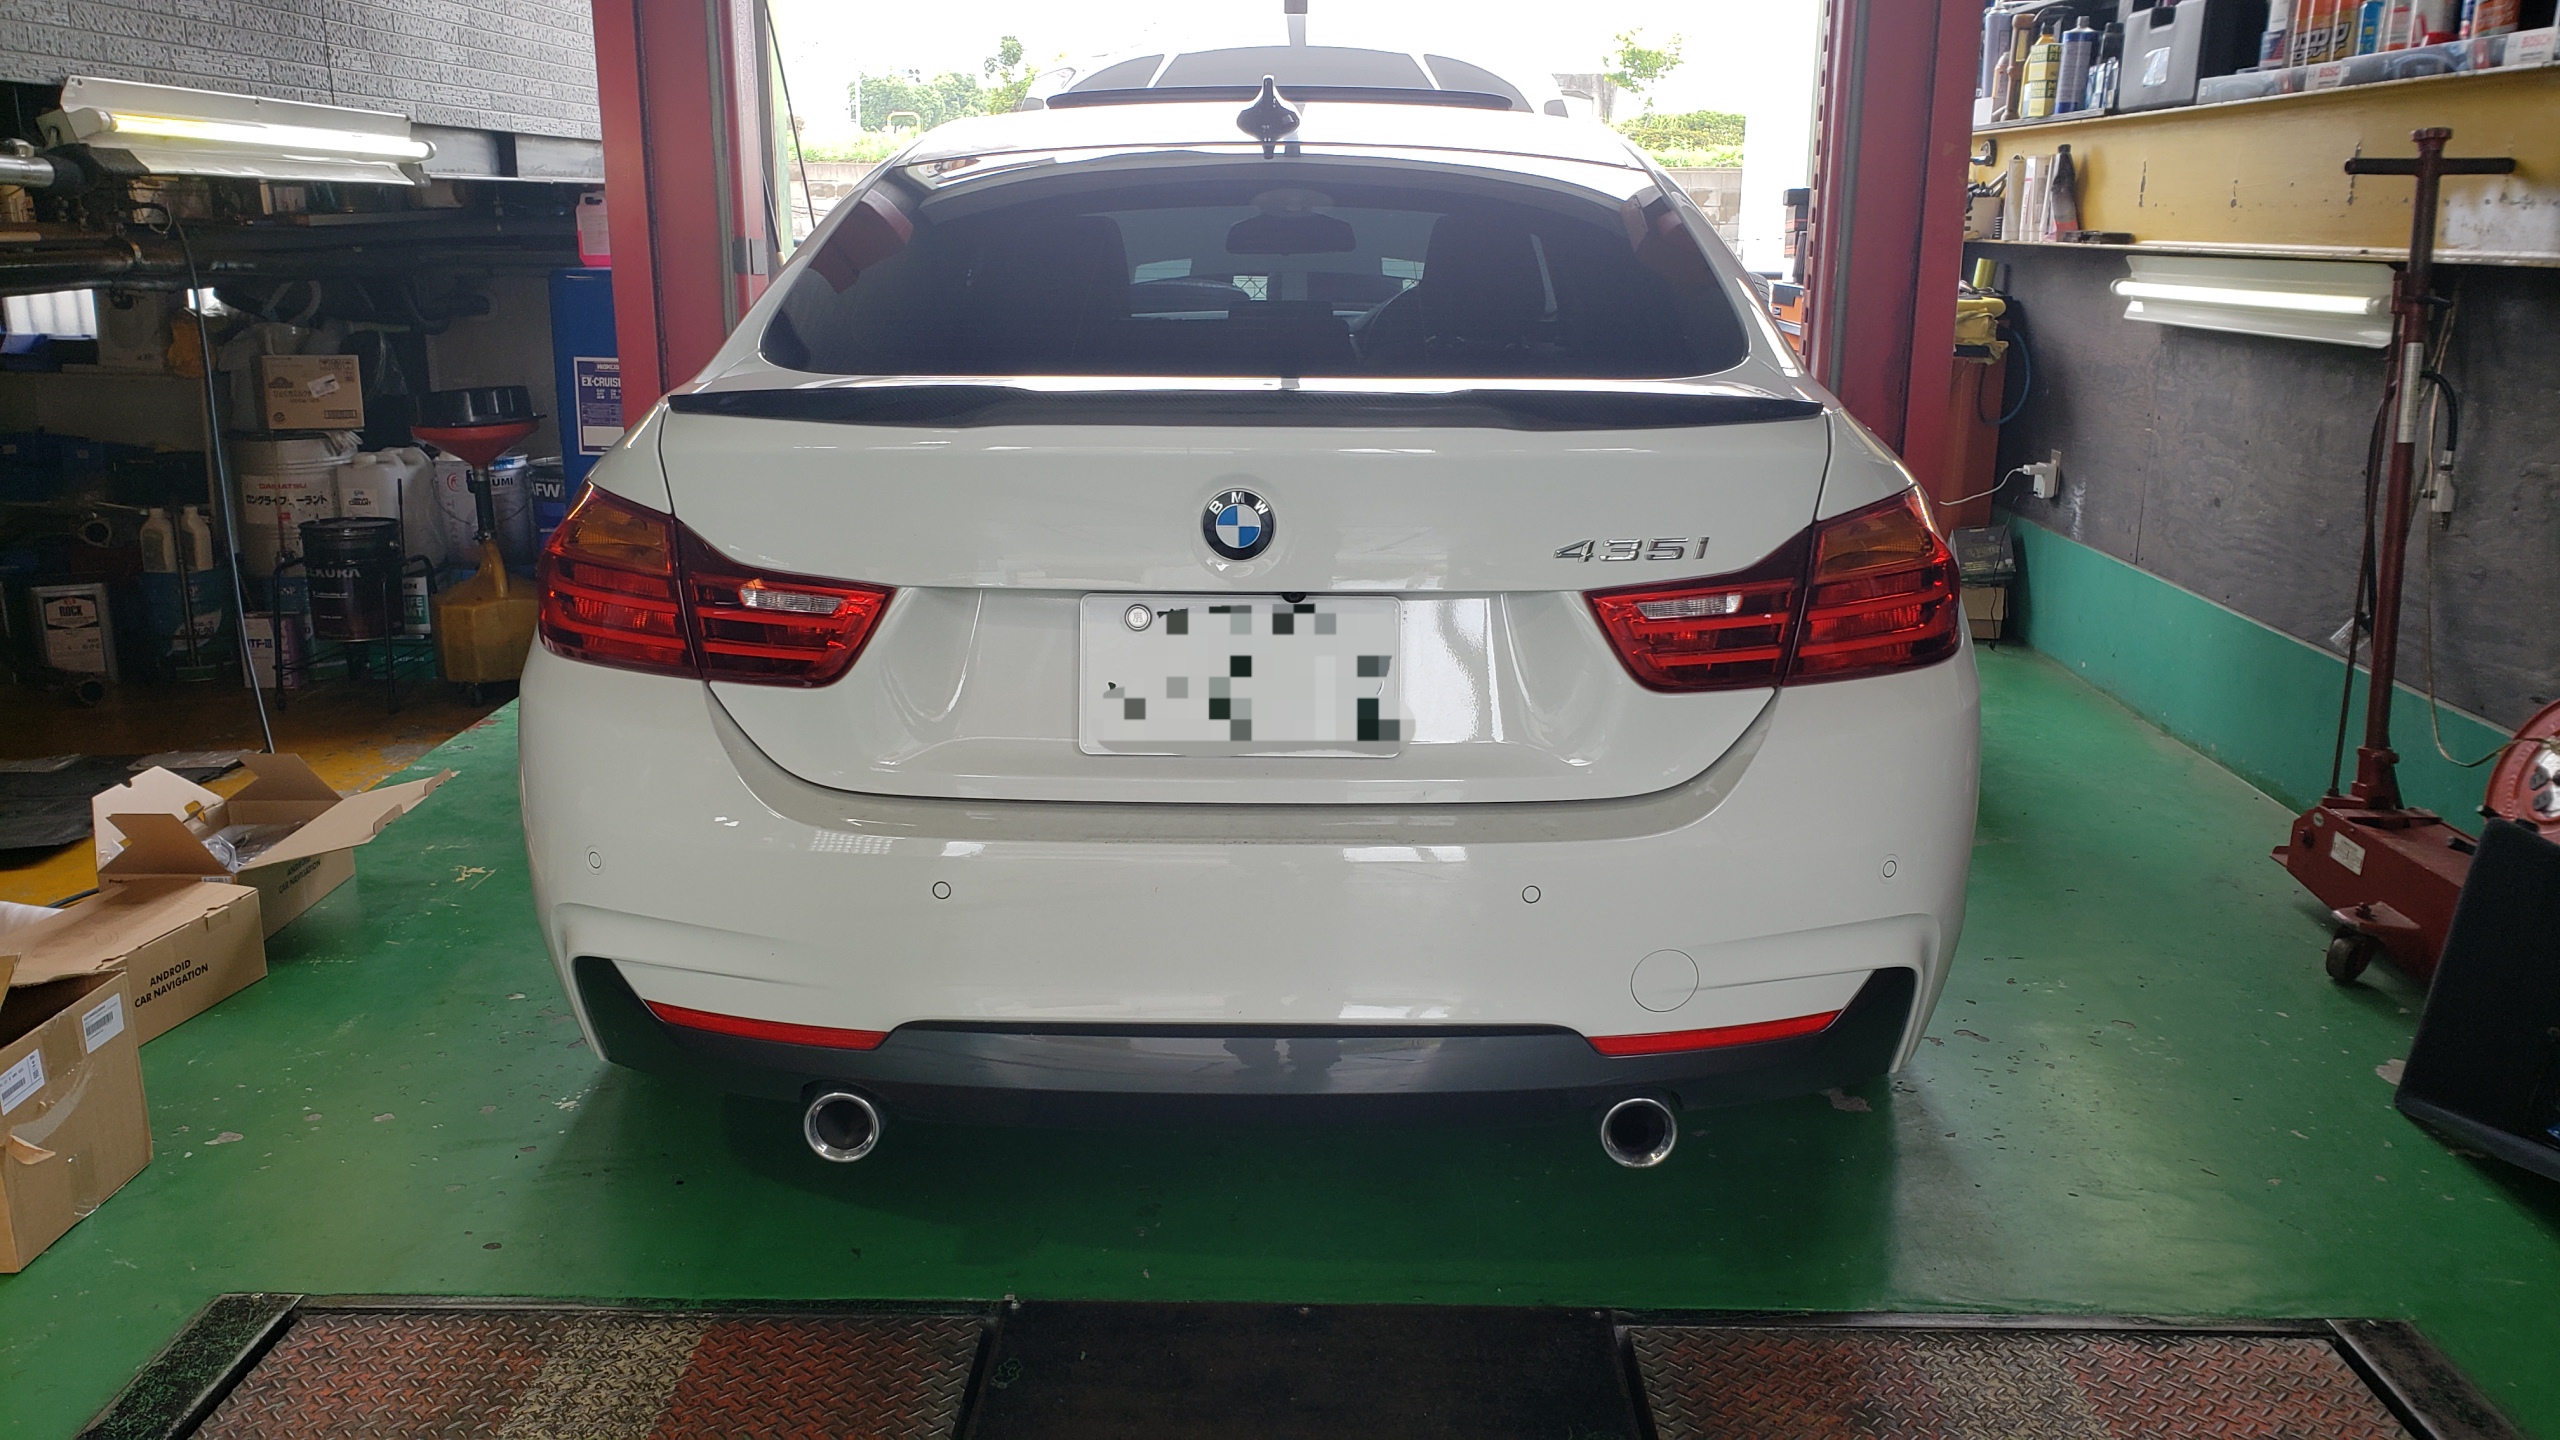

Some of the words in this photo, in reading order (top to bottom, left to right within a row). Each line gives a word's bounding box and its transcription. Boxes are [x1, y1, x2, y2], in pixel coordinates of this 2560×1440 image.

[2319, 66, 2341, 78] BOSC
[492, 477, 514, 487] UMI
[246, 494, 328, 509] ロングライフーラント
[1208, 490, 1270, 516] BMW
[59, 605, 83, 617] ROCK
[150, 959, 191, 987] ANDROID
[134, 992, 152, 1008] CAR
[153, 963, 209, 999] NAVIGATION
